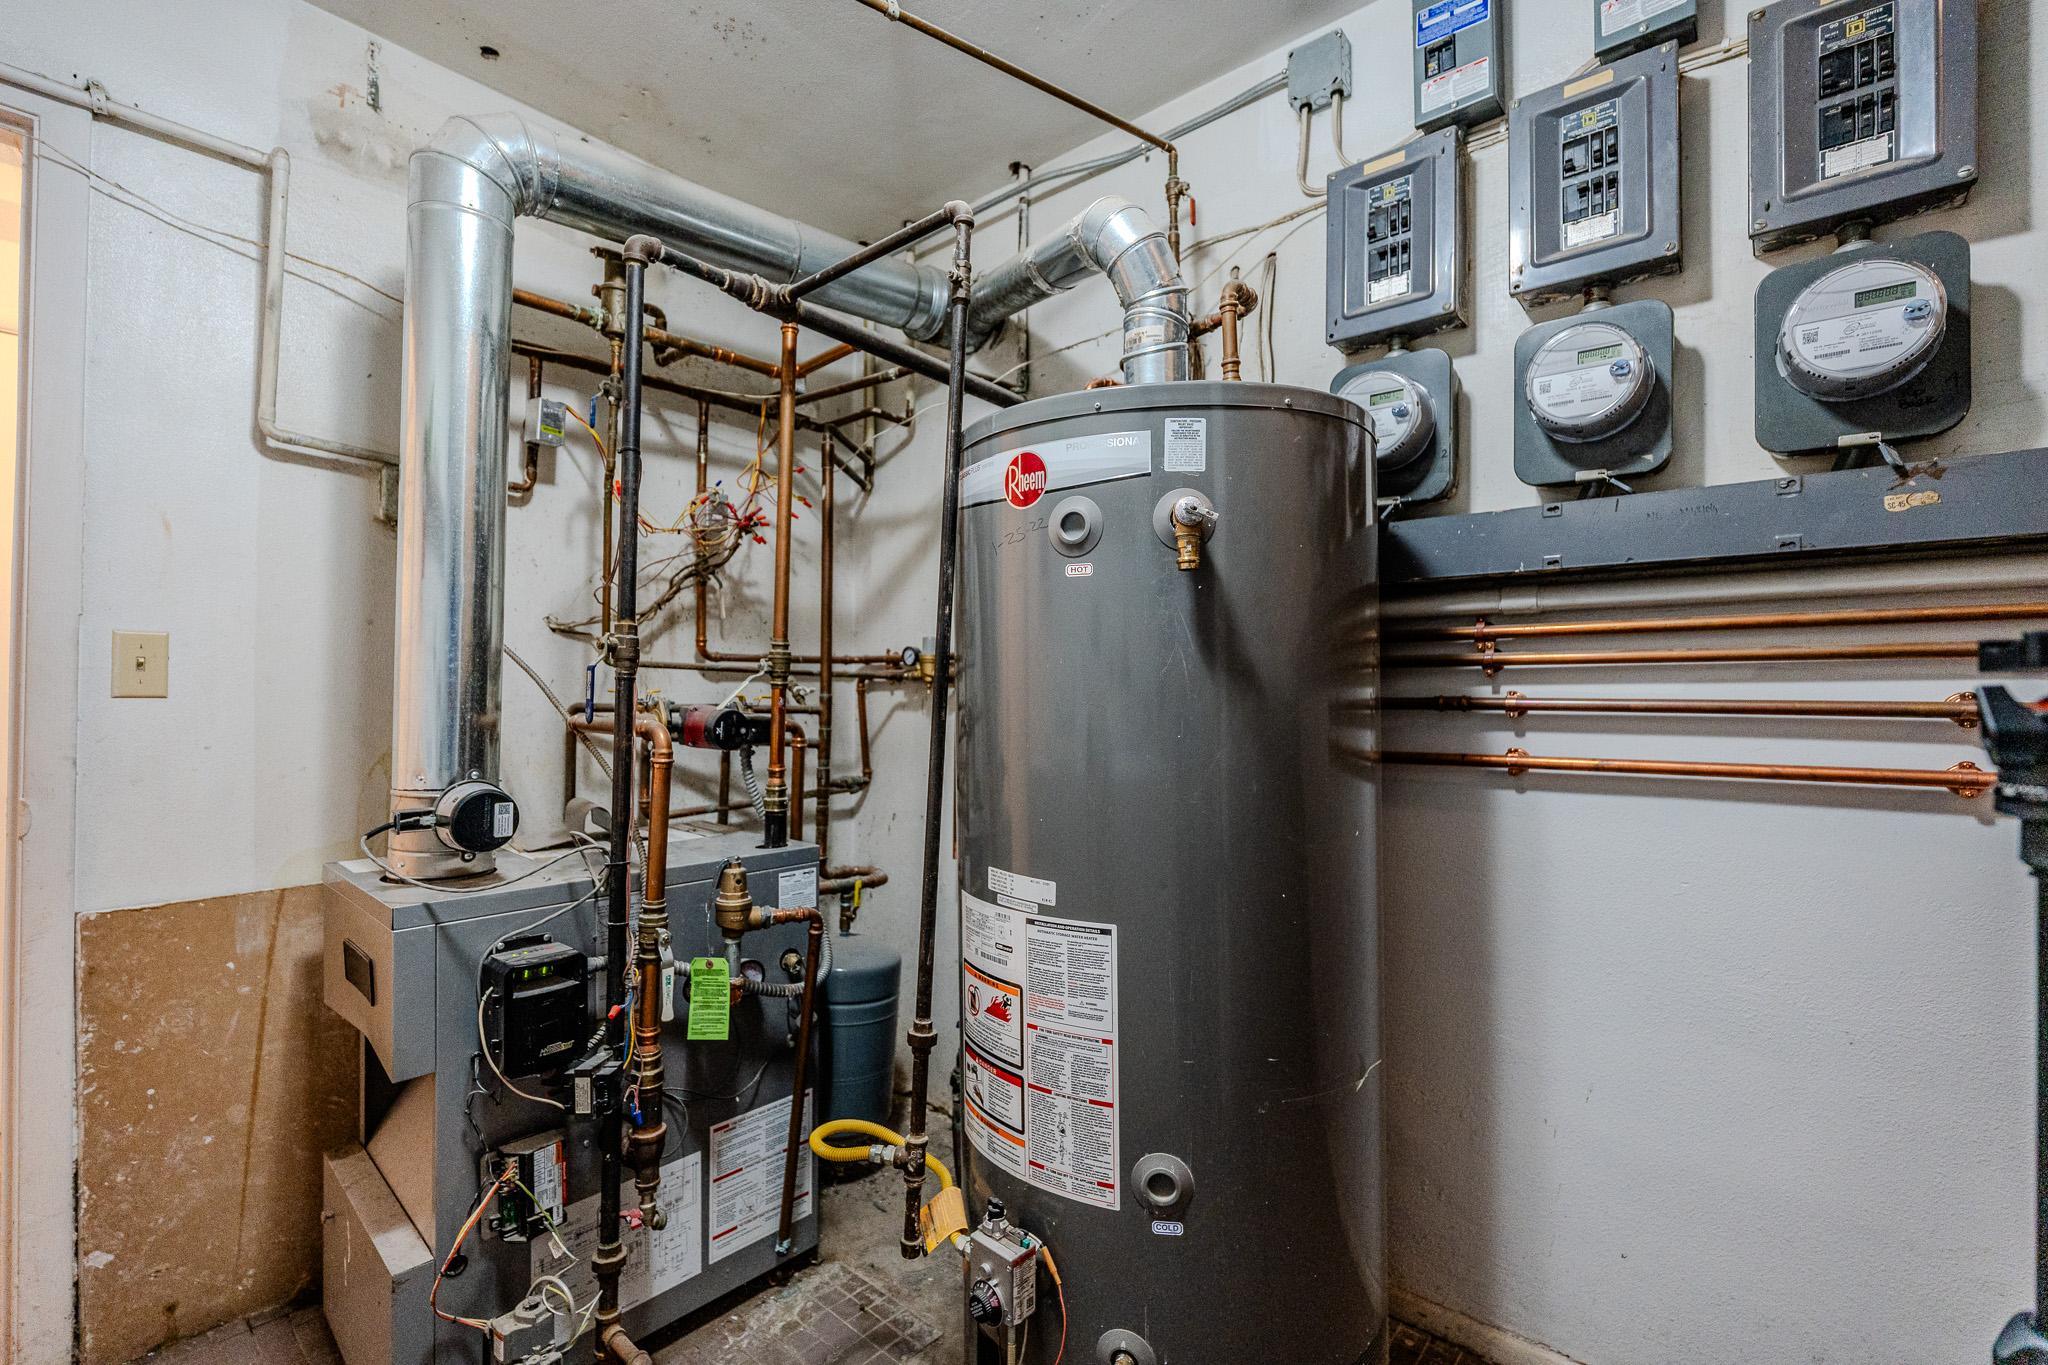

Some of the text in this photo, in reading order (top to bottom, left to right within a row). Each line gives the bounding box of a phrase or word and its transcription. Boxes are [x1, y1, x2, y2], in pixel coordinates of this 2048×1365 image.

[1843, 15, 1859, 25] LOAD
[1441, 448, 1448, 458] 2
[1008, 453, 1046, 500] Rheem
[1070, 566, 1089, 574] HOT
[1155, 1223, 1179, 1232] COLD
